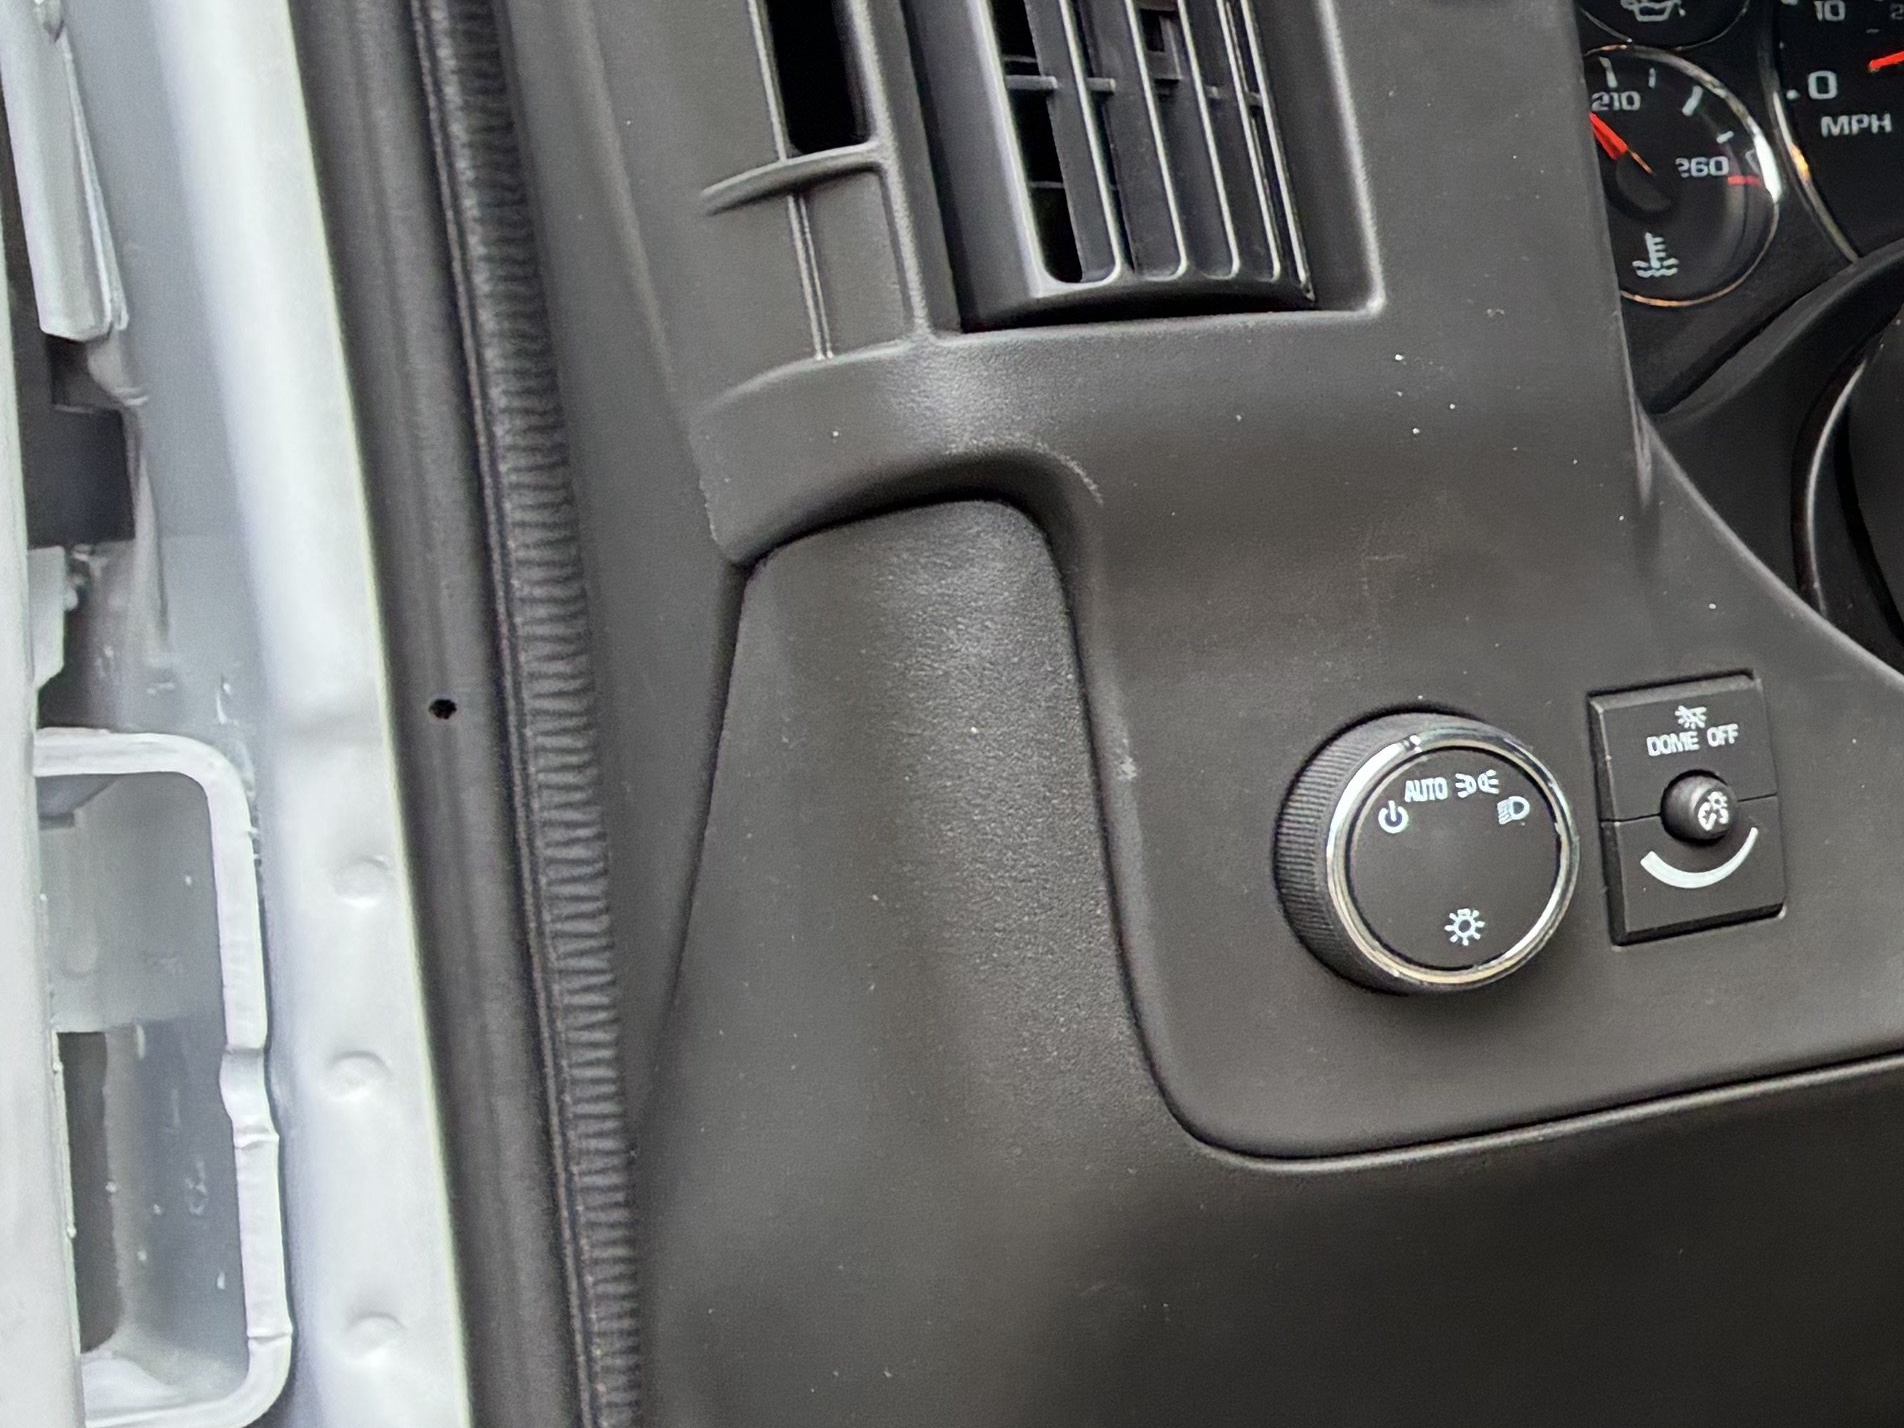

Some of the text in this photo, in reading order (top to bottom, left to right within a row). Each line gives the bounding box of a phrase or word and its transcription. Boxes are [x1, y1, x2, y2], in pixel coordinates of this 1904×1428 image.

[1814, 0, 1846, 21] 10
[1807, 70, 1838, 100] 0
[1591, 90, 1641, 111] 210
[1820, 113, 1893, 137] MPH
[1646, 723, 1739, 756] DOME OFF
[1404, 776, 1448, 802] AUTO
